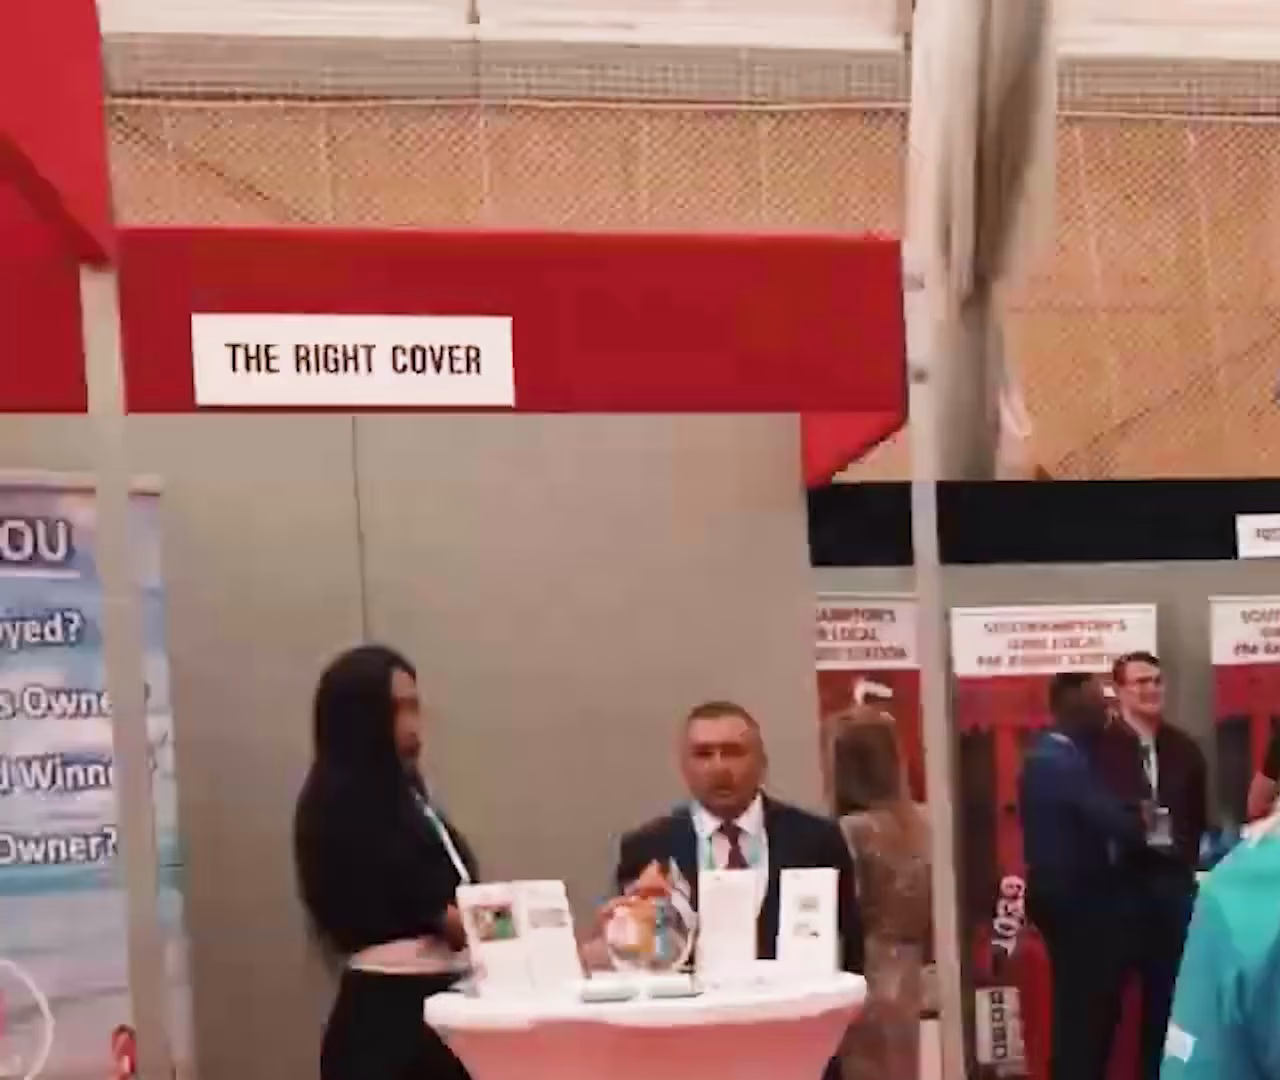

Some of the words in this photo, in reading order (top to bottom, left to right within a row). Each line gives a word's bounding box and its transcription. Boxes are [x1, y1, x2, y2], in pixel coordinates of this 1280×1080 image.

[225, 343, 280, 374] THE
[295, 344, 377, 375] RIGHT
[391, 345, 482, 376] COVER
[22, 685, 113, 719] Owne
[17, 754, 113, 790] Winn
